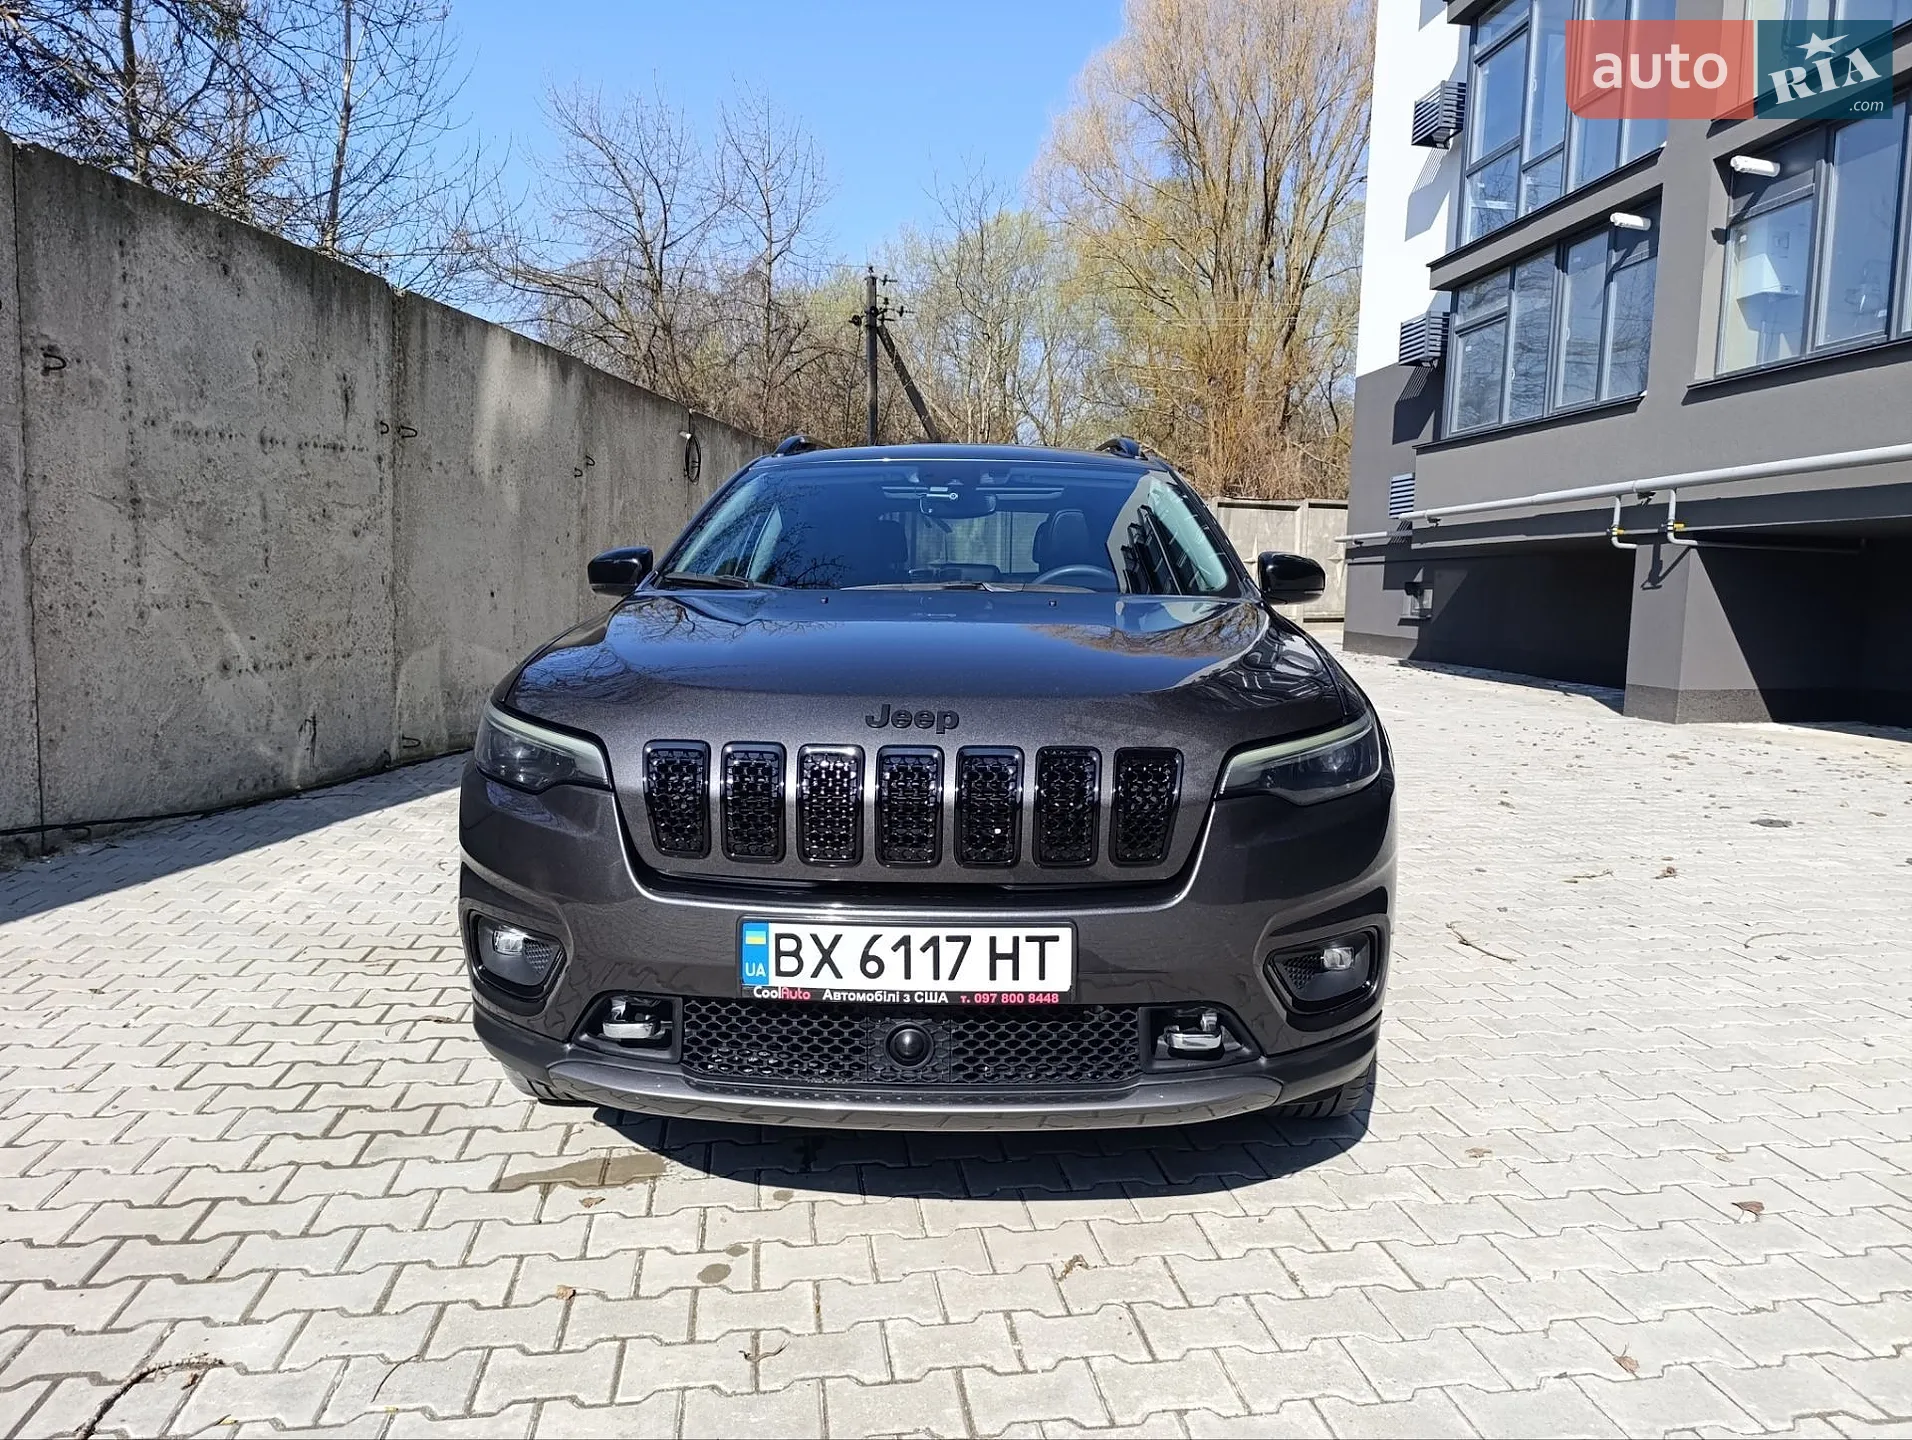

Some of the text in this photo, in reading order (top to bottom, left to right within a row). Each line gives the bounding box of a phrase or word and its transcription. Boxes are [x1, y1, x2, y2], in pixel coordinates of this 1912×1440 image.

[865, 703, 960, 734] Jeep
[774, 932, 1060, 981] BX 6117 HT
[745, 962, 766, 977] UA
[753, 986, 811, 1000] CoolAuto
[822, 988, 900, 1003] Автомобілі
[914, 991, 949, 1003] США
[974, 993, 998, 1004] 097
[1001, 993, 1025, 1004] 800
[1028, 993, 1059, 1004] 8448
